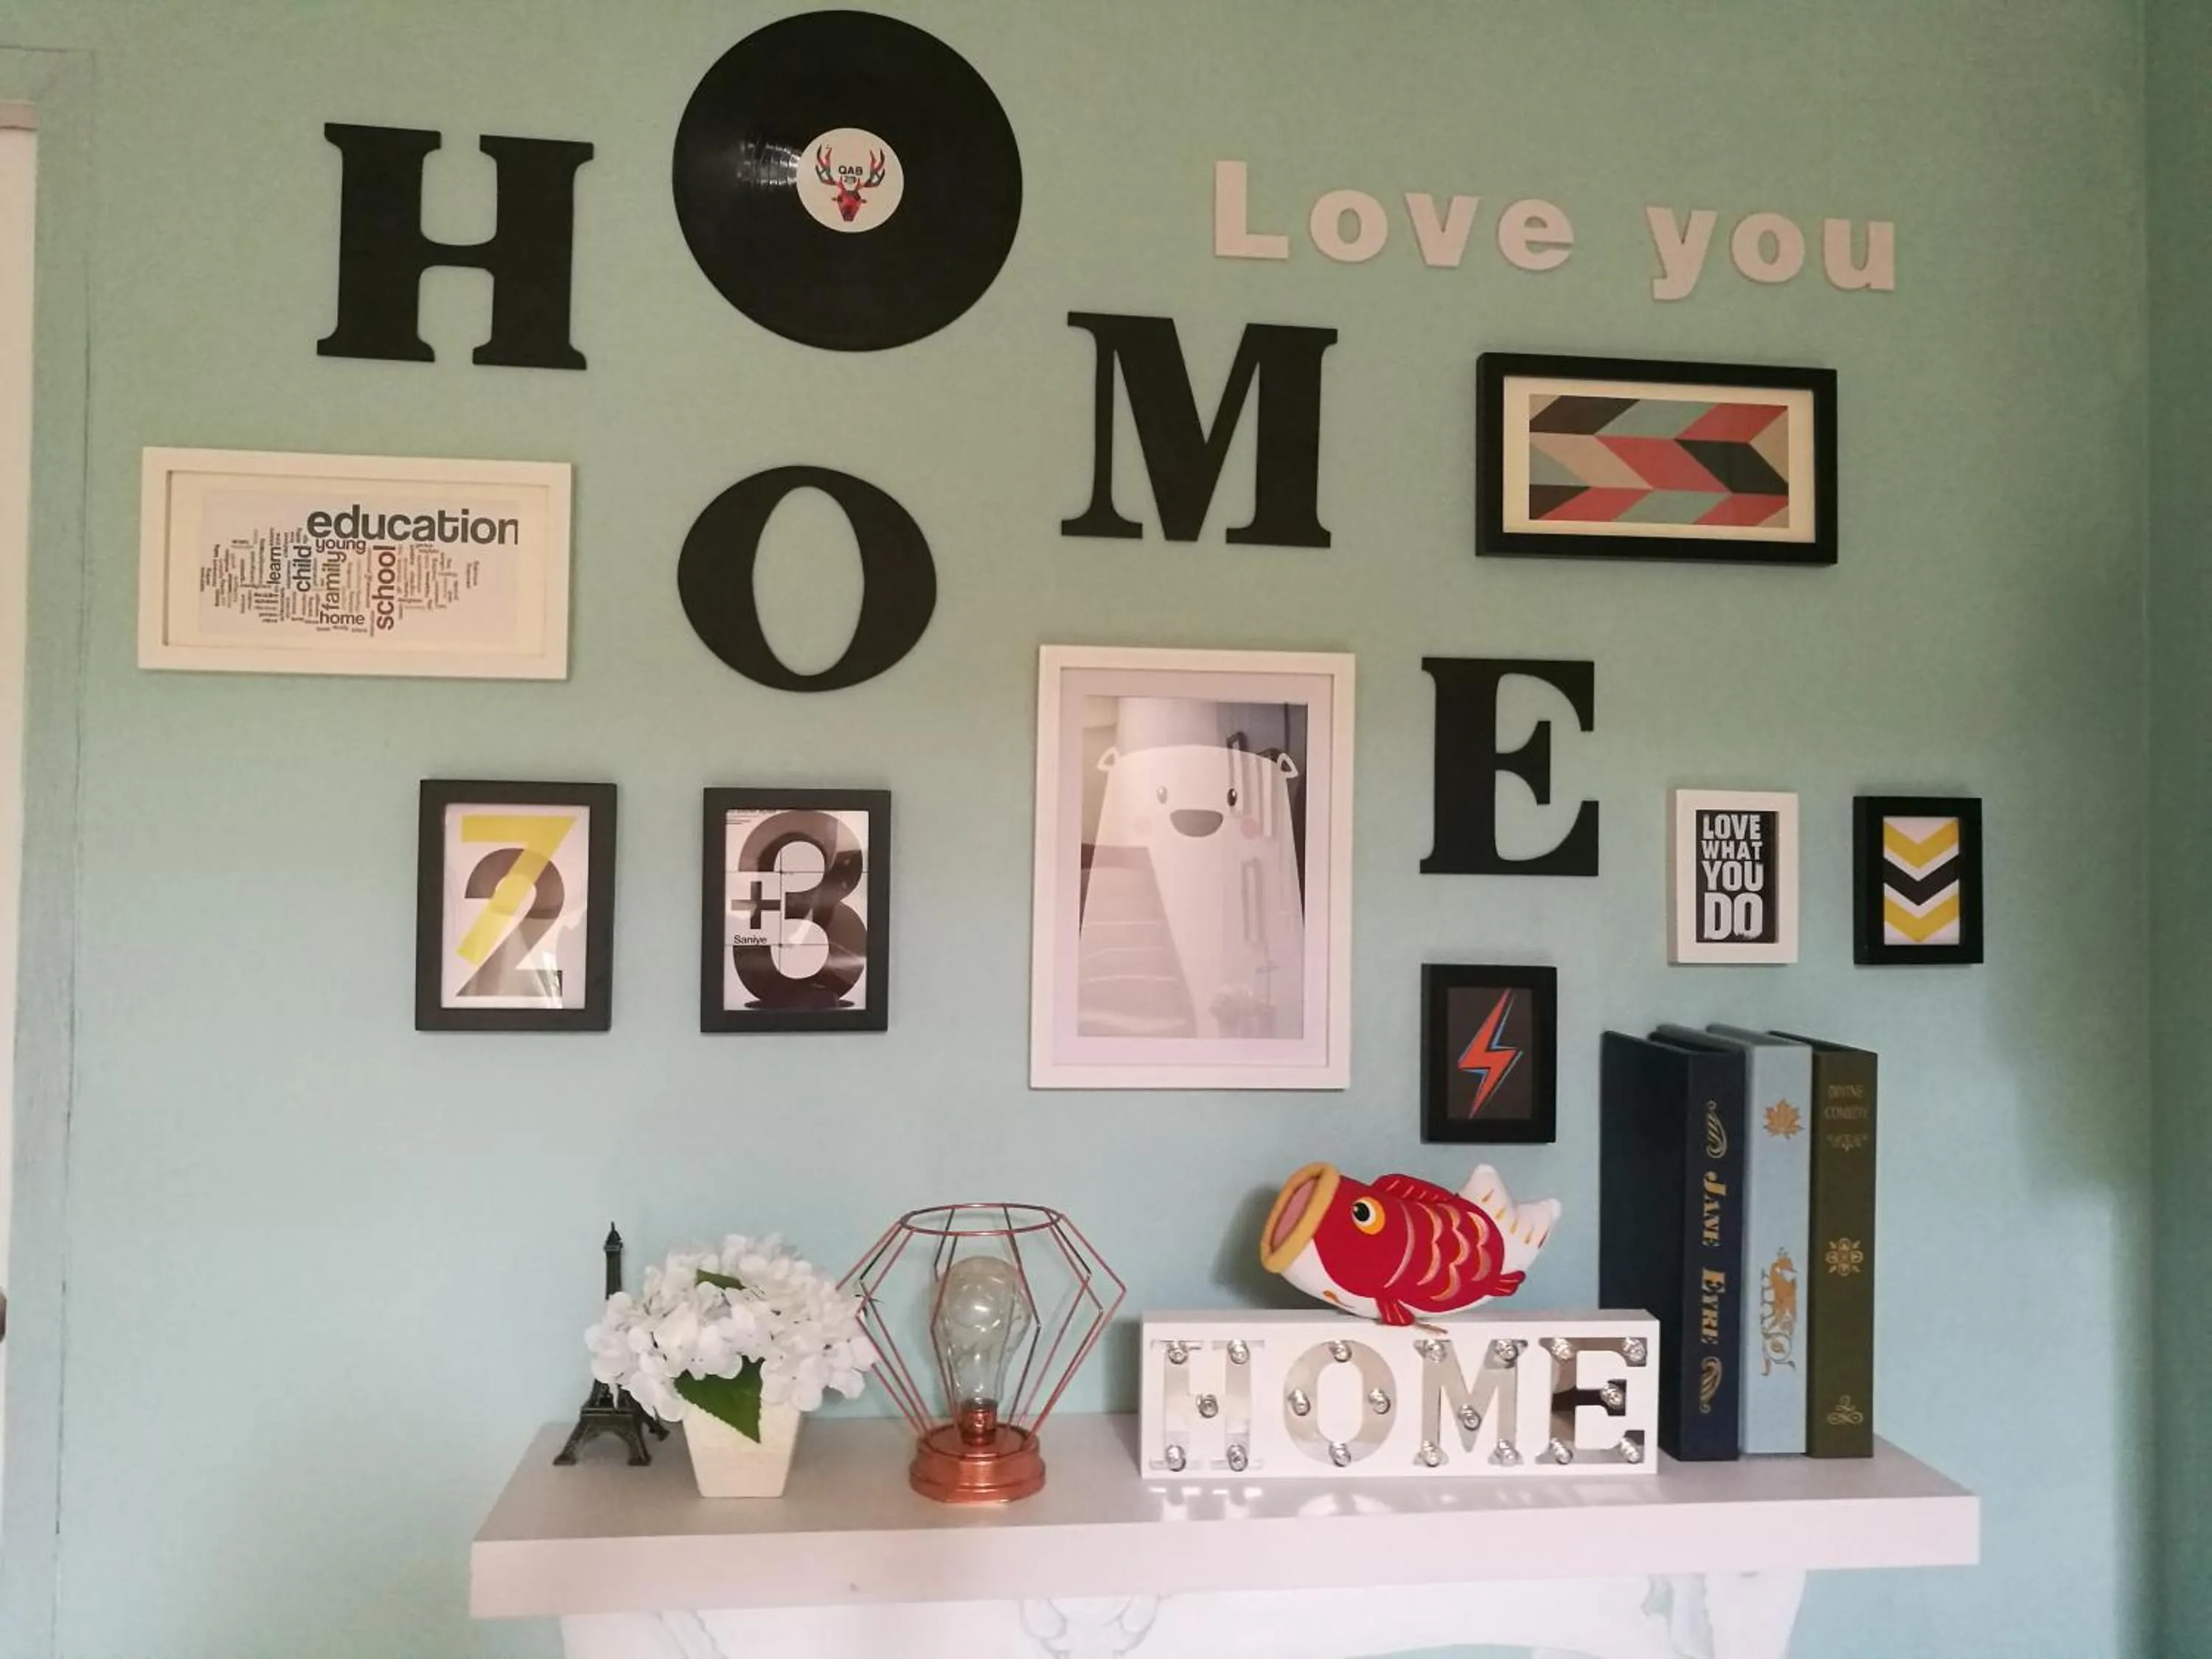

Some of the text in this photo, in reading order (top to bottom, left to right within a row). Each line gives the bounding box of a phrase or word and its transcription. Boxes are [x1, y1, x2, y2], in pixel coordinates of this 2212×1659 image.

[1213, 160, 1894, 299] Love you
[307, 504, 518, 545] education
[267, 546, 281, 585] learn
[316, 539, 366, 554] young
[293, 546, 312, 592] child
[321, 552, 347, 611] family
[372, 545, 395, 630] school
[320, 611, 365, 625] home
[1703, 814, 1761, 840] LOVE
[1702, 841, 1763, 860] WHAT
[1702, 860, 1764, 891] YOU
[1703, 892, 1763, 940] DO
[1150, 1337, 1648, 1469] HOME
